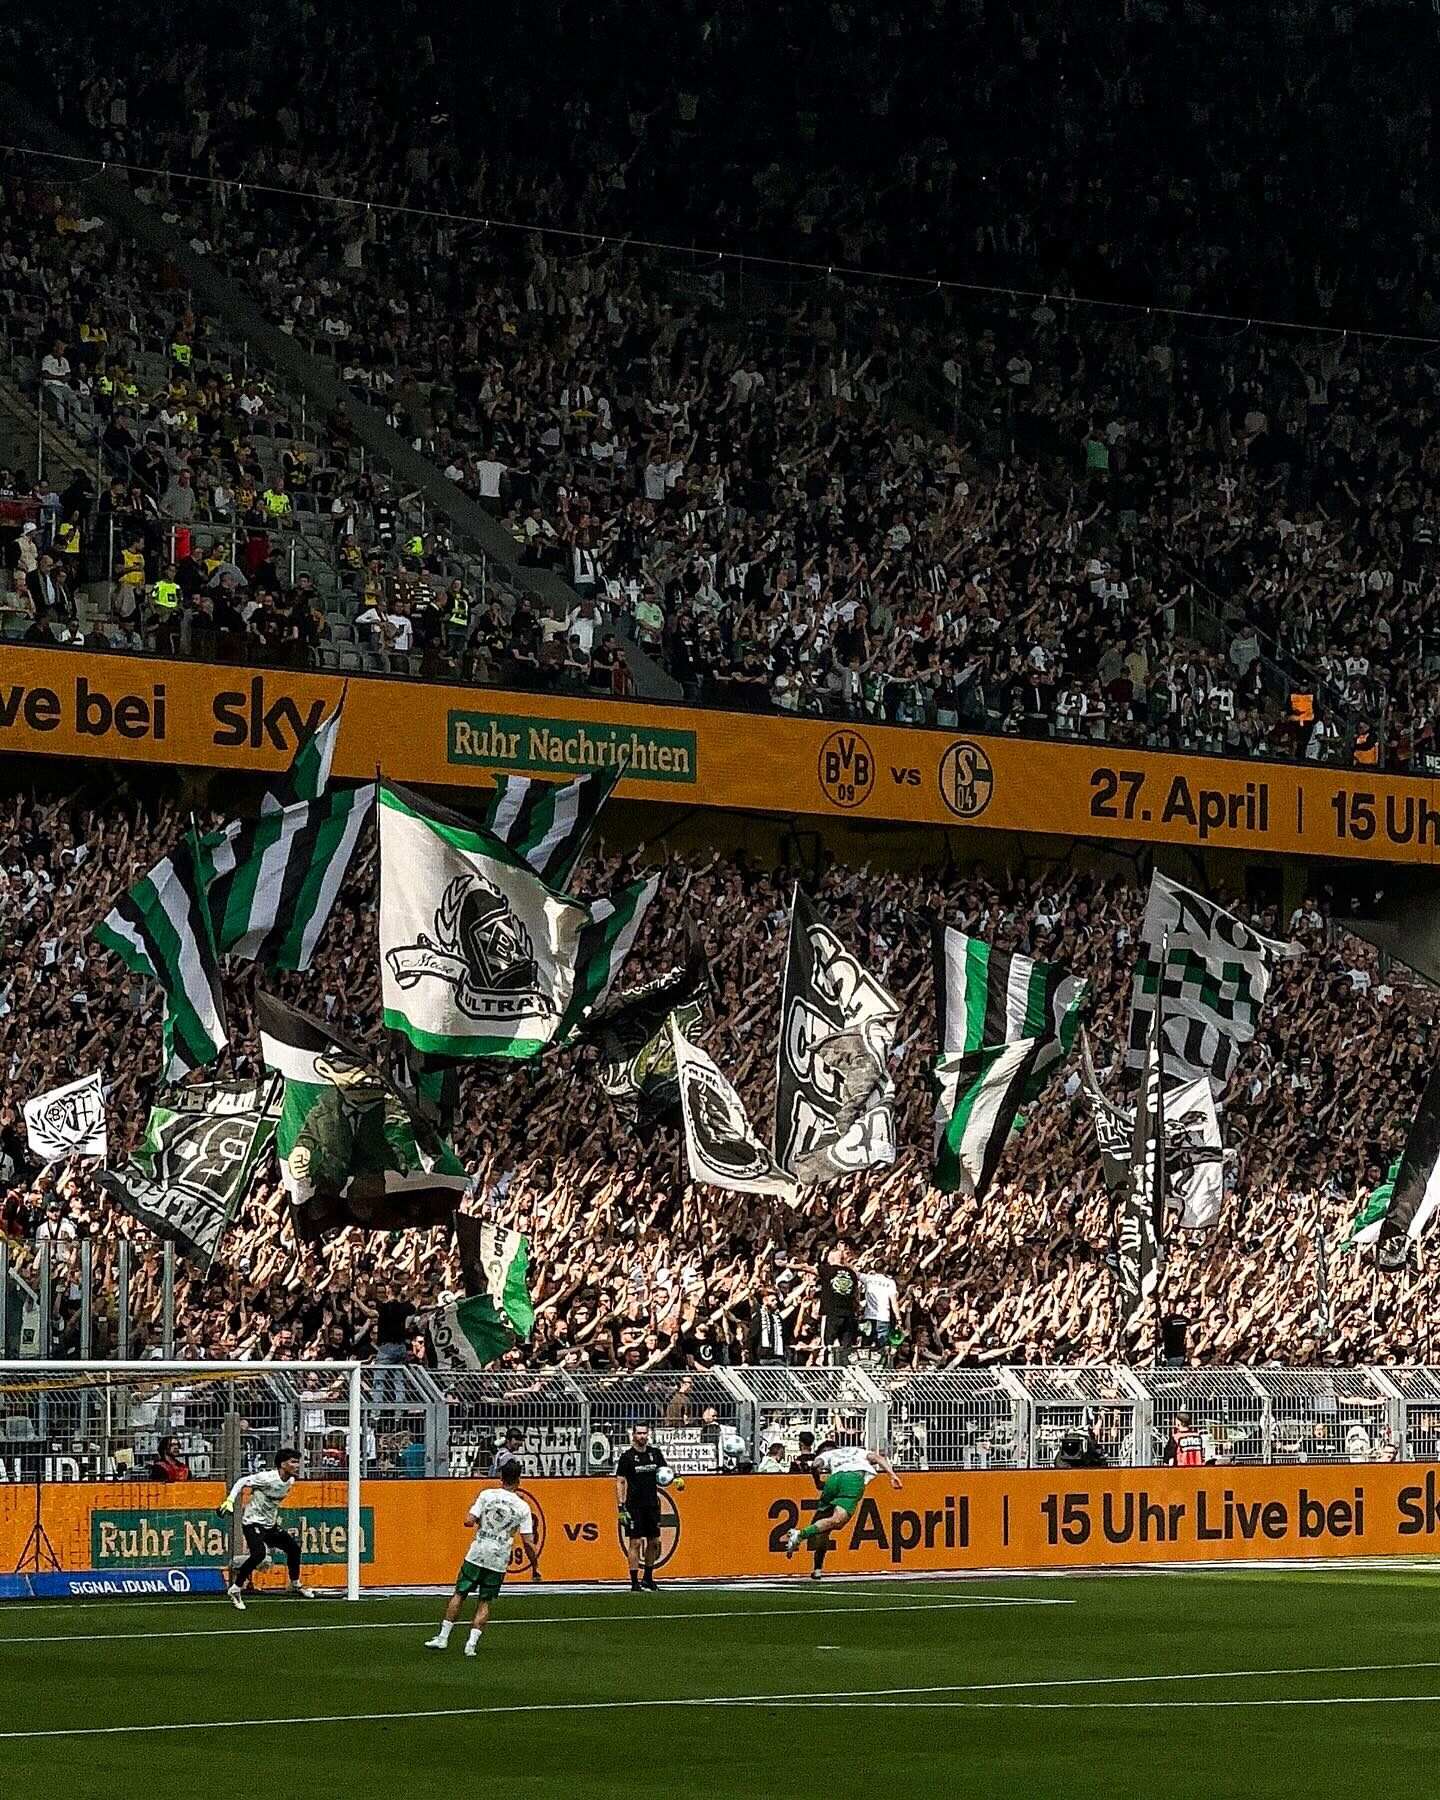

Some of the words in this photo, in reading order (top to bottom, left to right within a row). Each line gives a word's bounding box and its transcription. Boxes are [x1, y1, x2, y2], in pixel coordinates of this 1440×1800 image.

[76, 676, 166, 740] bei
[212, 675, 326, 752] sky
[454, 721, 521, 759] Ruhr
[528, 727, 690, 774] Nachrichten
[826, 737, 869, 786] BVB
[838, 783, 855, 801] 09
[890, 766, 922, 786] vs
[1090, 767, 1151, 821] 27.
[1161, 775, 1268, 839] April
[1331, 789, 1377, 841] 15
[100, 1518, 174, 1557] Ruhr
[563, 1523, 599, 1541] vs
[848, 1496, 969, 1563] April
[1041, 1493, 1092, 1546] 15
[1102, 1491, 1185, 1544] Uhr
[1197, 1489, 1288, 1541] Live
[1299, 1487, 1364, 1537] bei
[69, 1580, 123, 1595] SIGNAL
[124, 1578, 167, 1593] IDUNA
